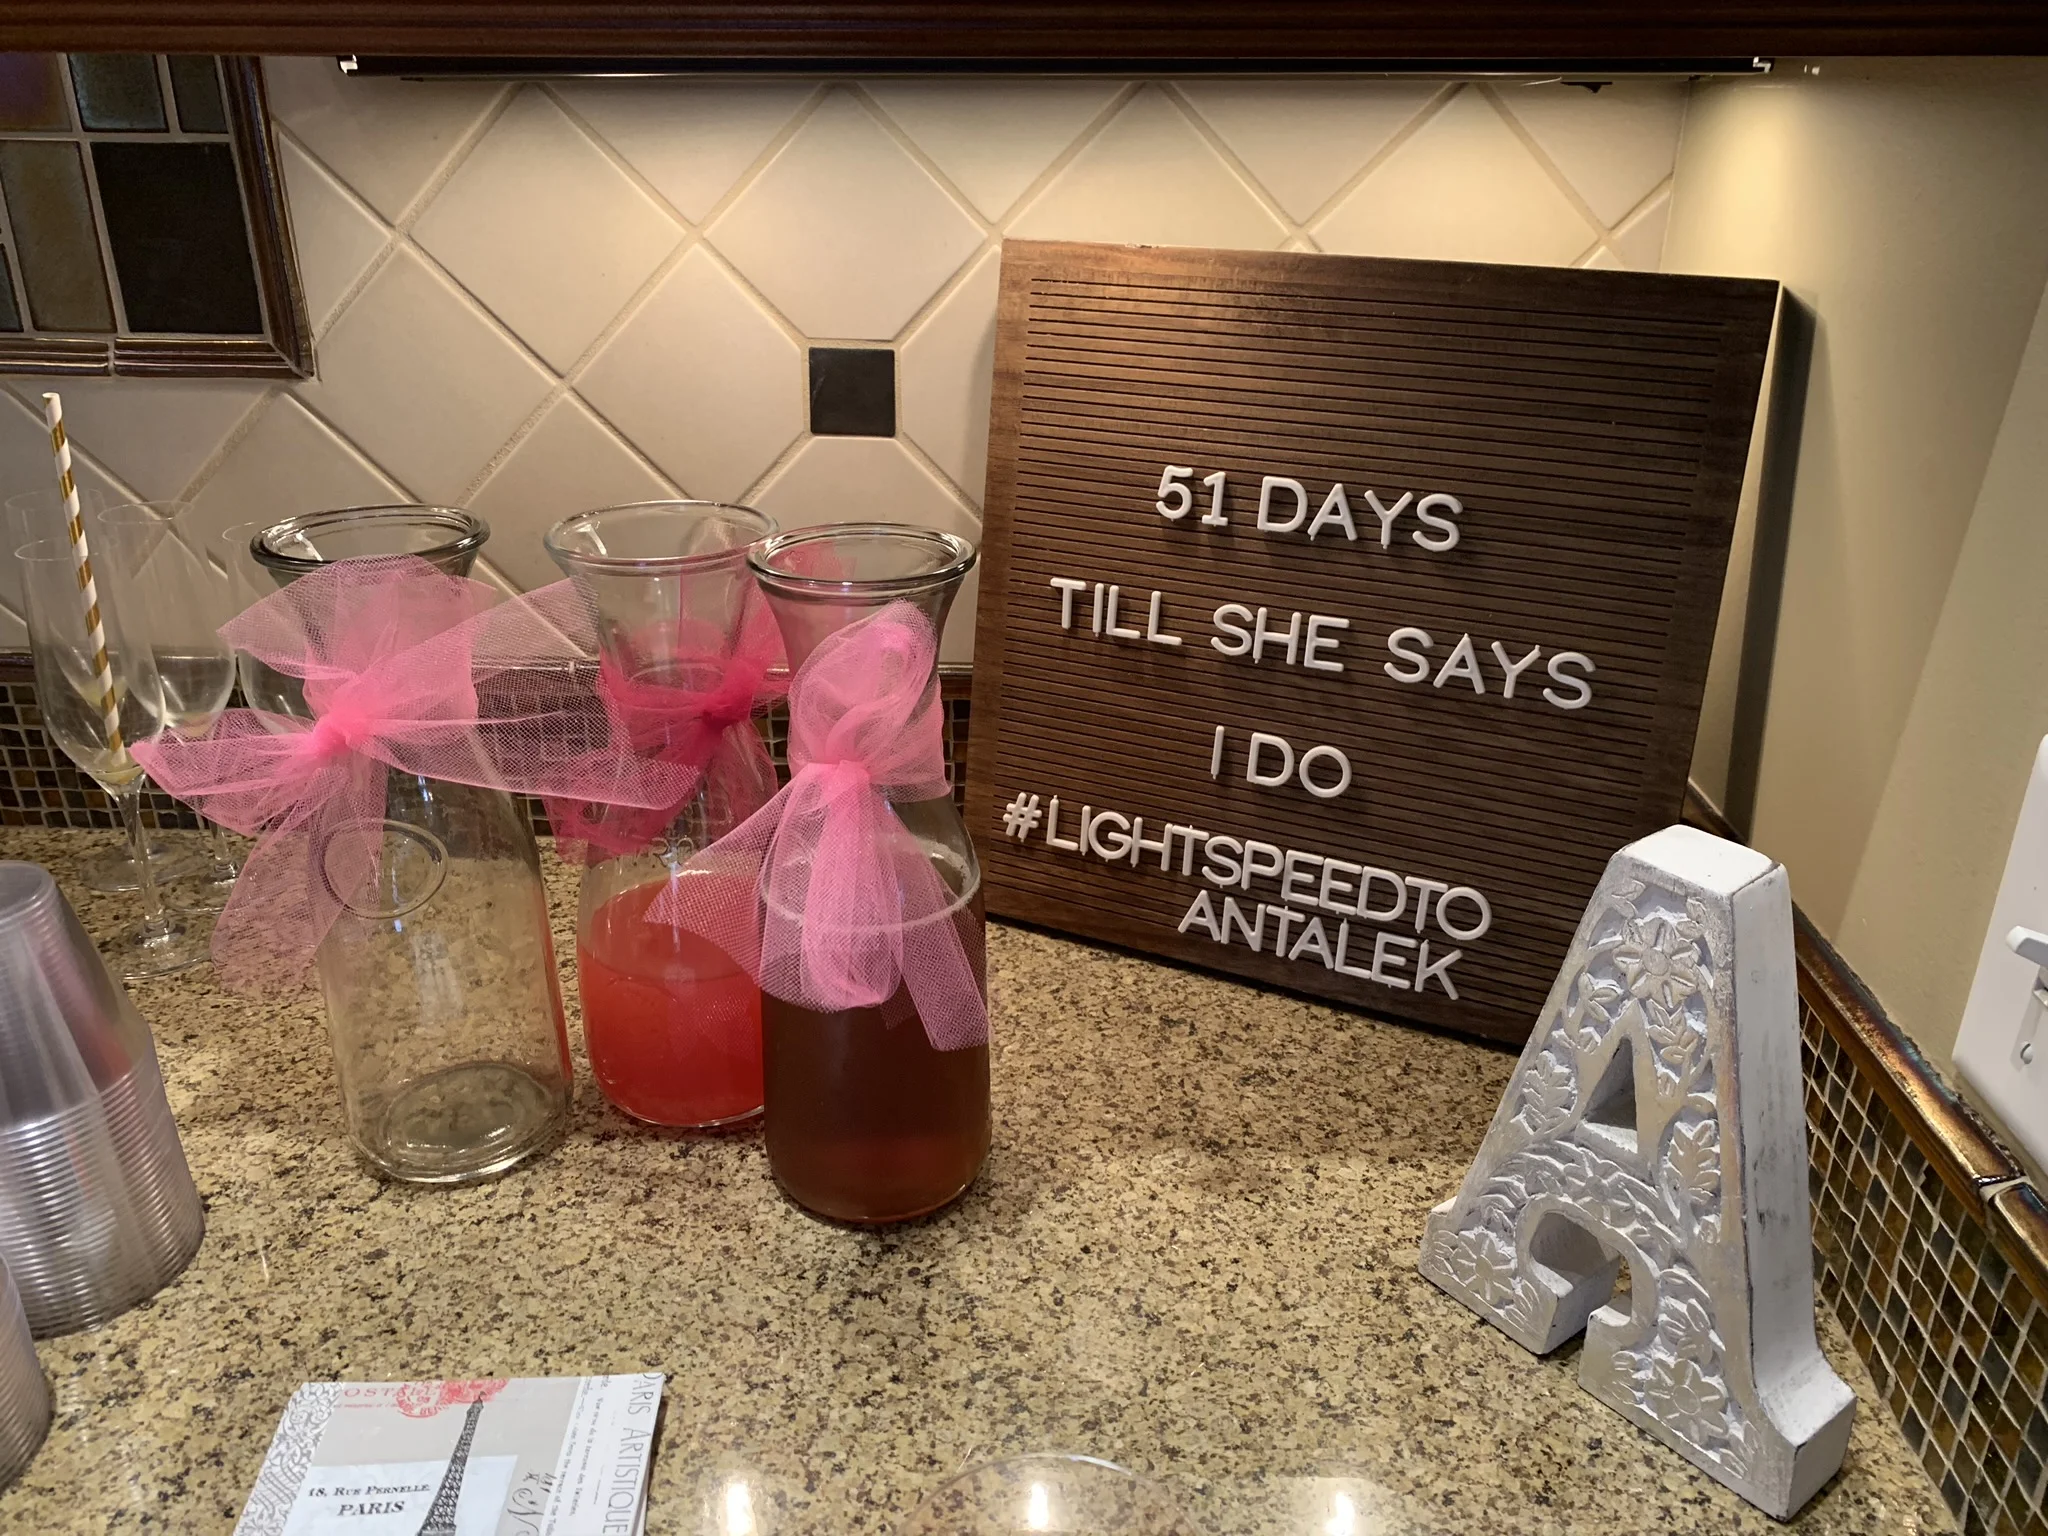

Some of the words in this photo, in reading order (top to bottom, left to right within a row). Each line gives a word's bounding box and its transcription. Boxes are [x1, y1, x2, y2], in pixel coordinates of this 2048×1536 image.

[1155, 465, 1230, 527] 51
[1256, 476, 1463, 552] DAYS
[1050, 576, 1183, 647] TILL
[1210, 603, 1350, 673] SHE
[1384, 626, 1596, 710] SAYS
[1210, 725, 1225, 780] I
[1246, 731, 1352, 798] DO
[1002, 792, 1492, 942] #LIGHTSPEEDTO
[1177, 889, 1463, 1001] ANTALEK
[336, 1500, 405, 1517] PARIS
[602, 1427, 652, 1534] ARTISTIQUE
